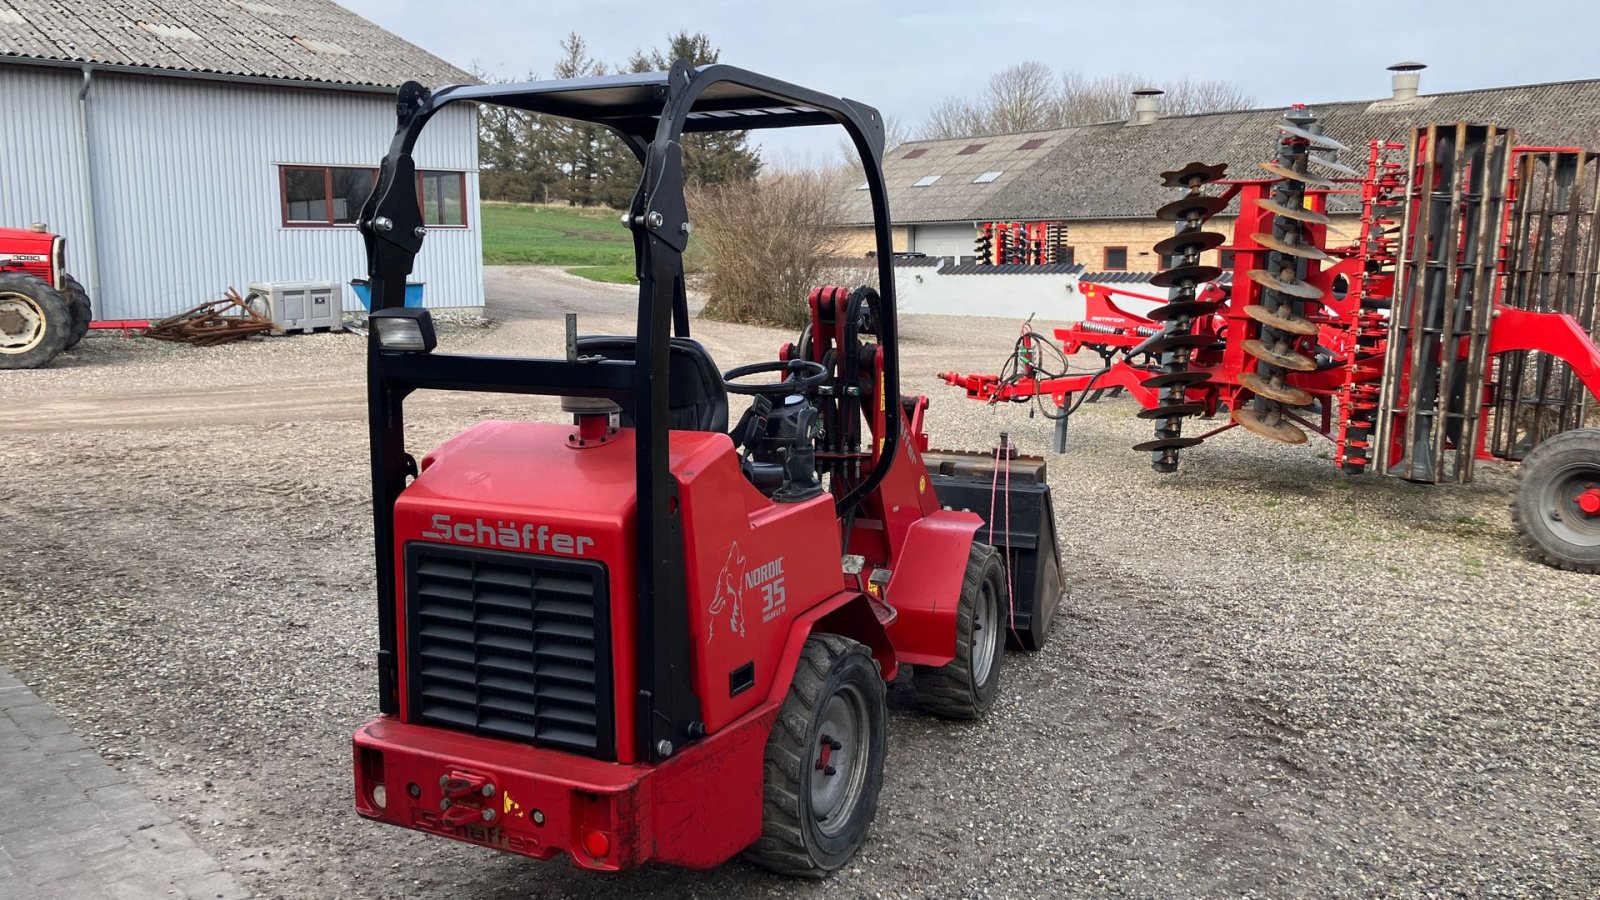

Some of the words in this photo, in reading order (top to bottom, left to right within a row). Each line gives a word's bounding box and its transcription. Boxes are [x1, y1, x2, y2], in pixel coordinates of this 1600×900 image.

[422, 513, 595, 555] Schäffer
[745, 556, 784, 590] NORDIC
[761, 576, 786, 613] 35
